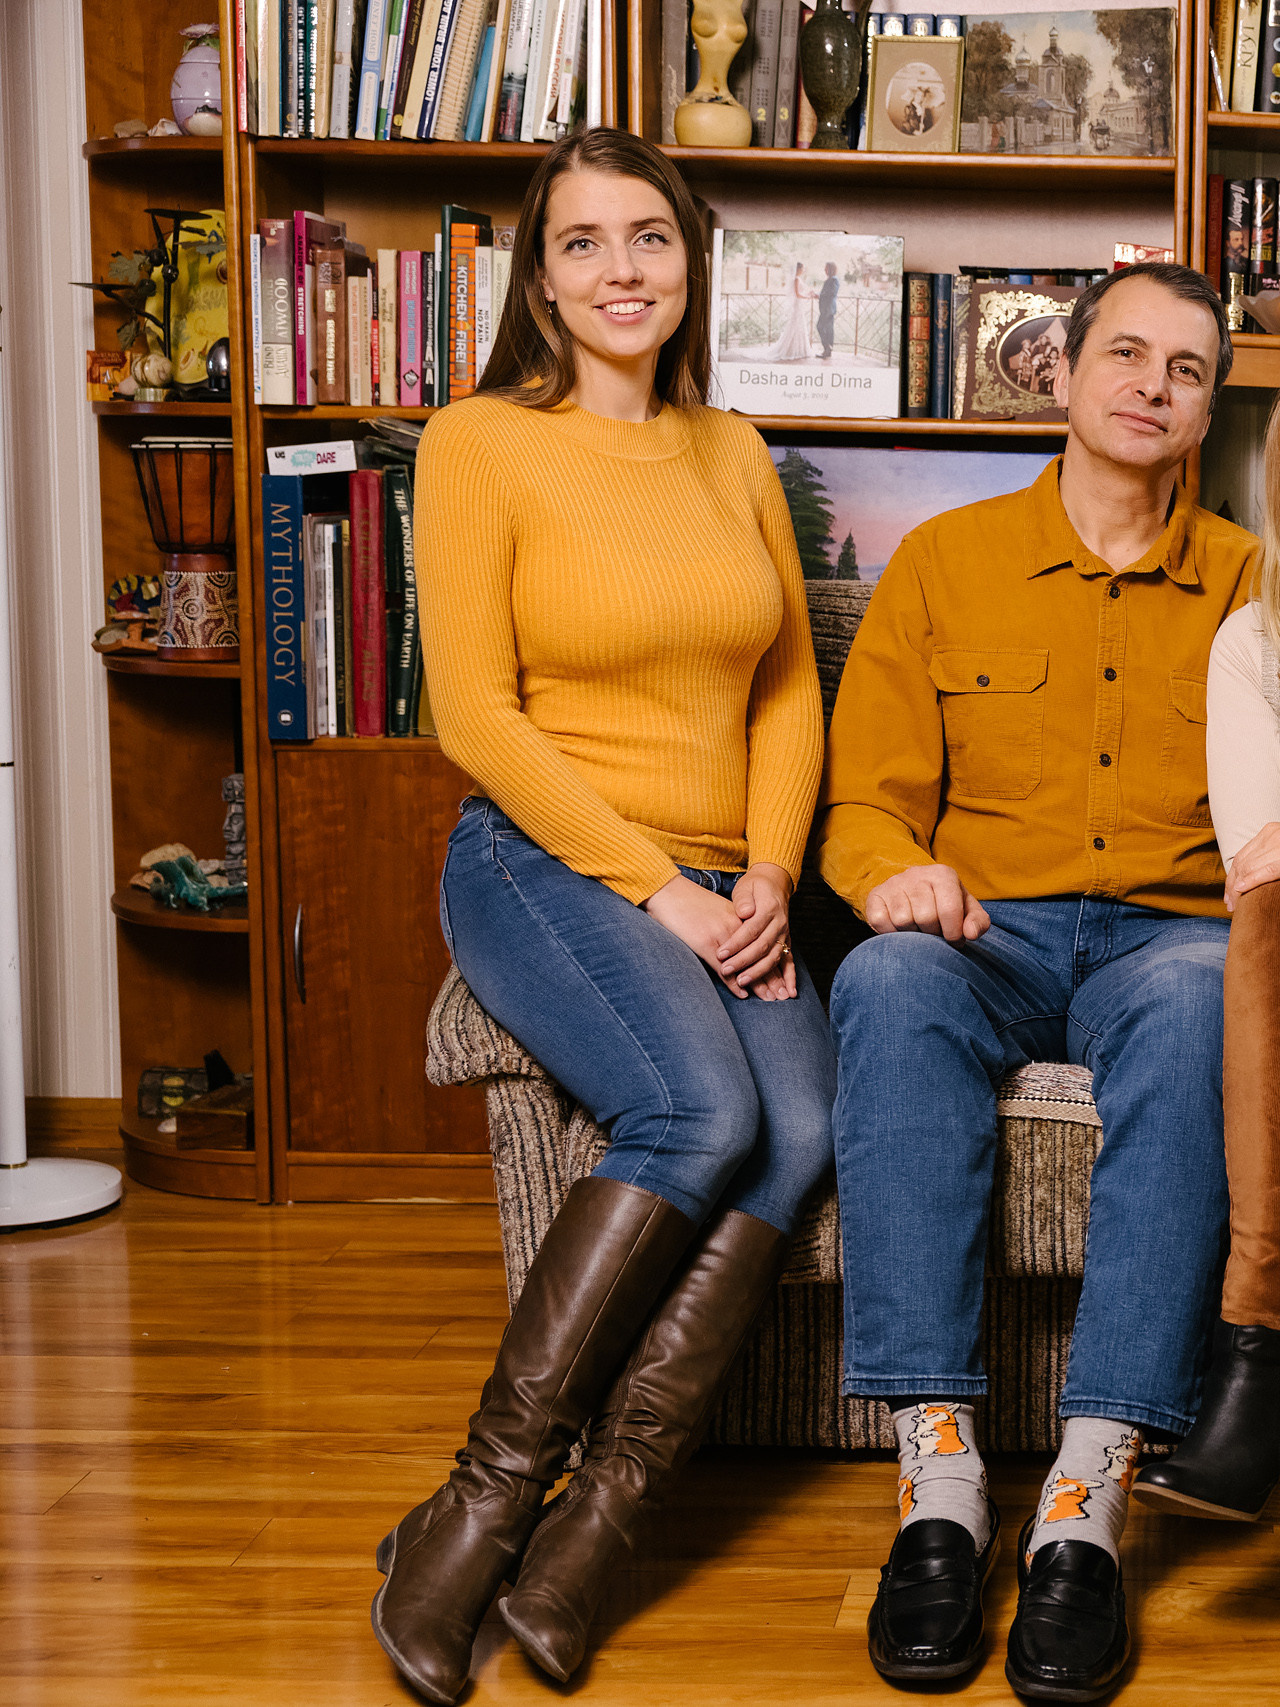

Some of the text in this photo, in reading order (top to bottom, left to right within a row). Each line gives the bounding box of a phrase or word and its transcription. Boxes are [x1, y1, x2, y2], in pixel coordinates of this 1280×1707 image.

[436, 18, 449, 43] BRAIN
[431, 43, 445, 69] YOUR
[1239, 25, 1257, 68] КРУГ
[425, 70, 438, 102] LOWER
[550, 57, 561, 98] РОССИИ
[757, 107, 766, 121] 2
[779, 107, 789, 120] 3
[297, 276, 304, 286] OF
[274, 277, 289, 338] ATWOOD
[297, 287, 305, 336] STRETCHING
[455, 265, 467, 363] KITCHEN FIRE!
[477, 309, 484, 322] NO
[484, 310, 490, 321] NO
[264, 346, 274, 369] BLIND
[739, 369, 872, 389] Dasha and Dima
[316, 452, 336, 464] DARE
[394, 487, 416, 668] THE WONDERS OF LIFE ON EARTH
[270, 502, 296, 687] MYTHOLOGY
[361, 649, 376, 701] ATLAS
